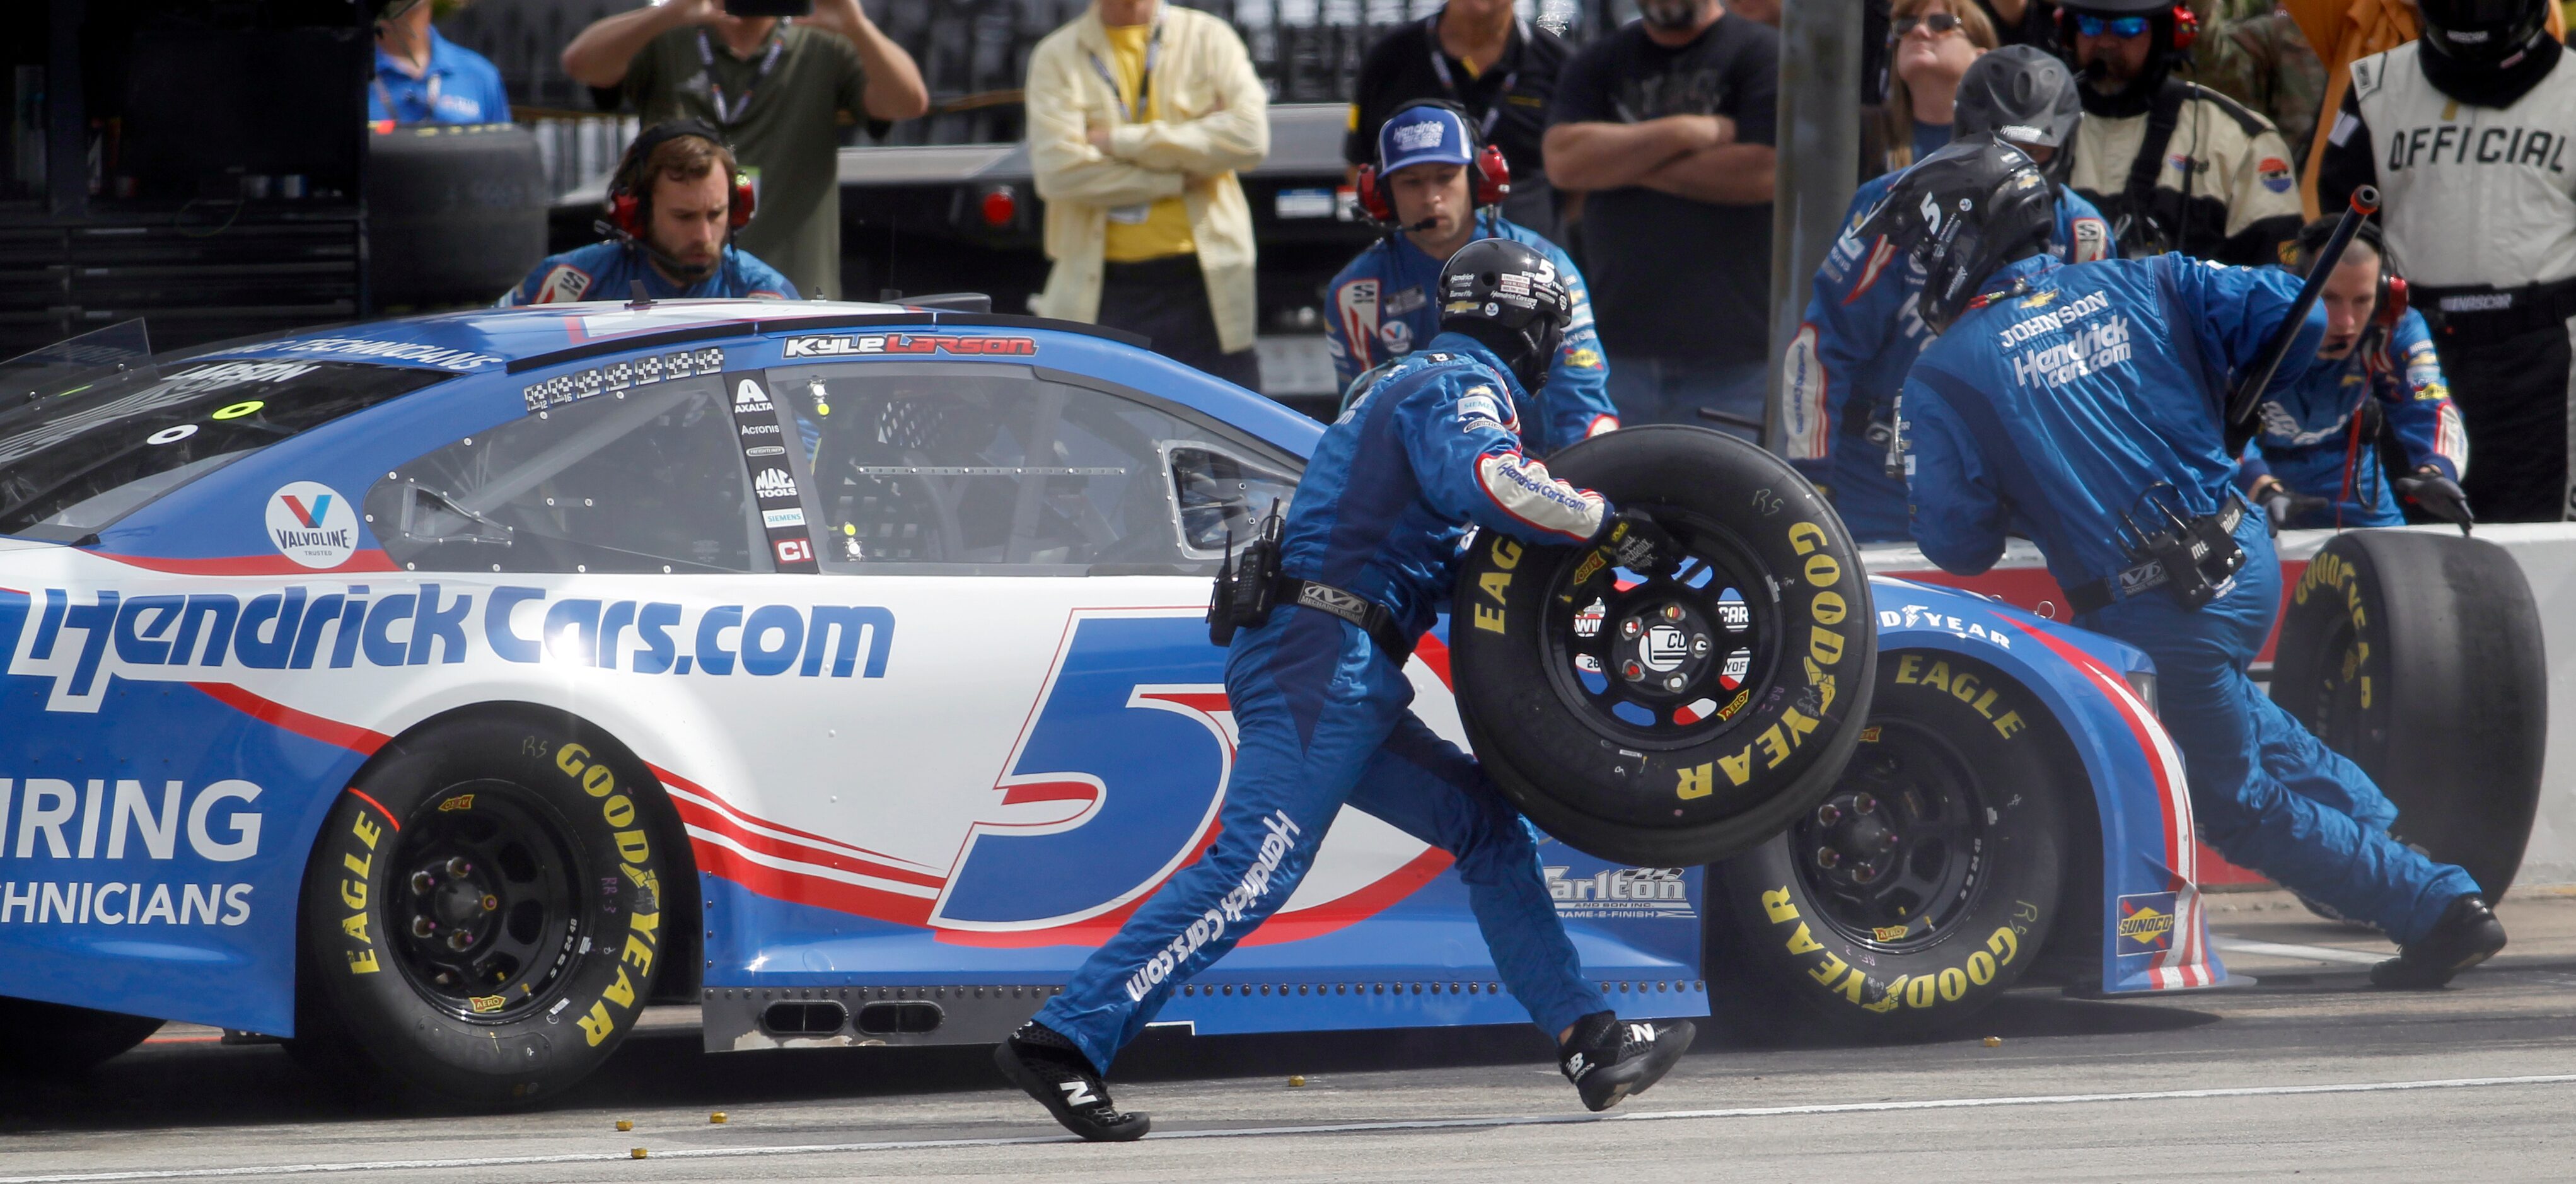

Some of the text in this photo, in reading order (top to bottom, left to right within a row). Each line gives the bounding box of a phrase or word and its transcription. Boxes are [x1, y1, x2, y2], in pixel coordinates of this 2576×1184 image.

[2389, 125, 2566, 171] OFFICIAL
[1920, 191, 1941, 235] 5
[1534, 258, 1555, 284] 5
[1999, 290, 2109, 348] JOHNSON
[2012, 314, 2130, 389] Hendrick
[2047, 342, 2132, 388] cars.com
[734, 402, 774, 413] AXALTA
[1464, 401, 1497, 414] SIEMEN
[741, 424, 780, 435] Acronis
[755, 468, 796, 490] MAC
[757, 488, 798, 498] TOOLS
[767, 514, 802, 523] SIEMENS
[276, 528, 351, 550] VALVOLINE
[777, 540, 811, 561] CI
[1474, 535, 1523, 635] EAG
[1301, 595, 1339, 614] MECHANIX
[2296, 552, 2372, 709] GOODYEAR
[1895, 654, 2026, 740] EAGLE
[933, 609, 1231, 929] 5
[341, 811, 382, 975] EAGLE
[556, 743, 660, 1047] GOODYEAR
[2120, 915, 2174, 936] SUNOCO
[1761, 885, 2017, 1011] GOODYEAR
[477, 997, 500, 1011] AERO
[1630, 1023, 1656, 1042] N
[1059, 1081, 1098, 1107] N
